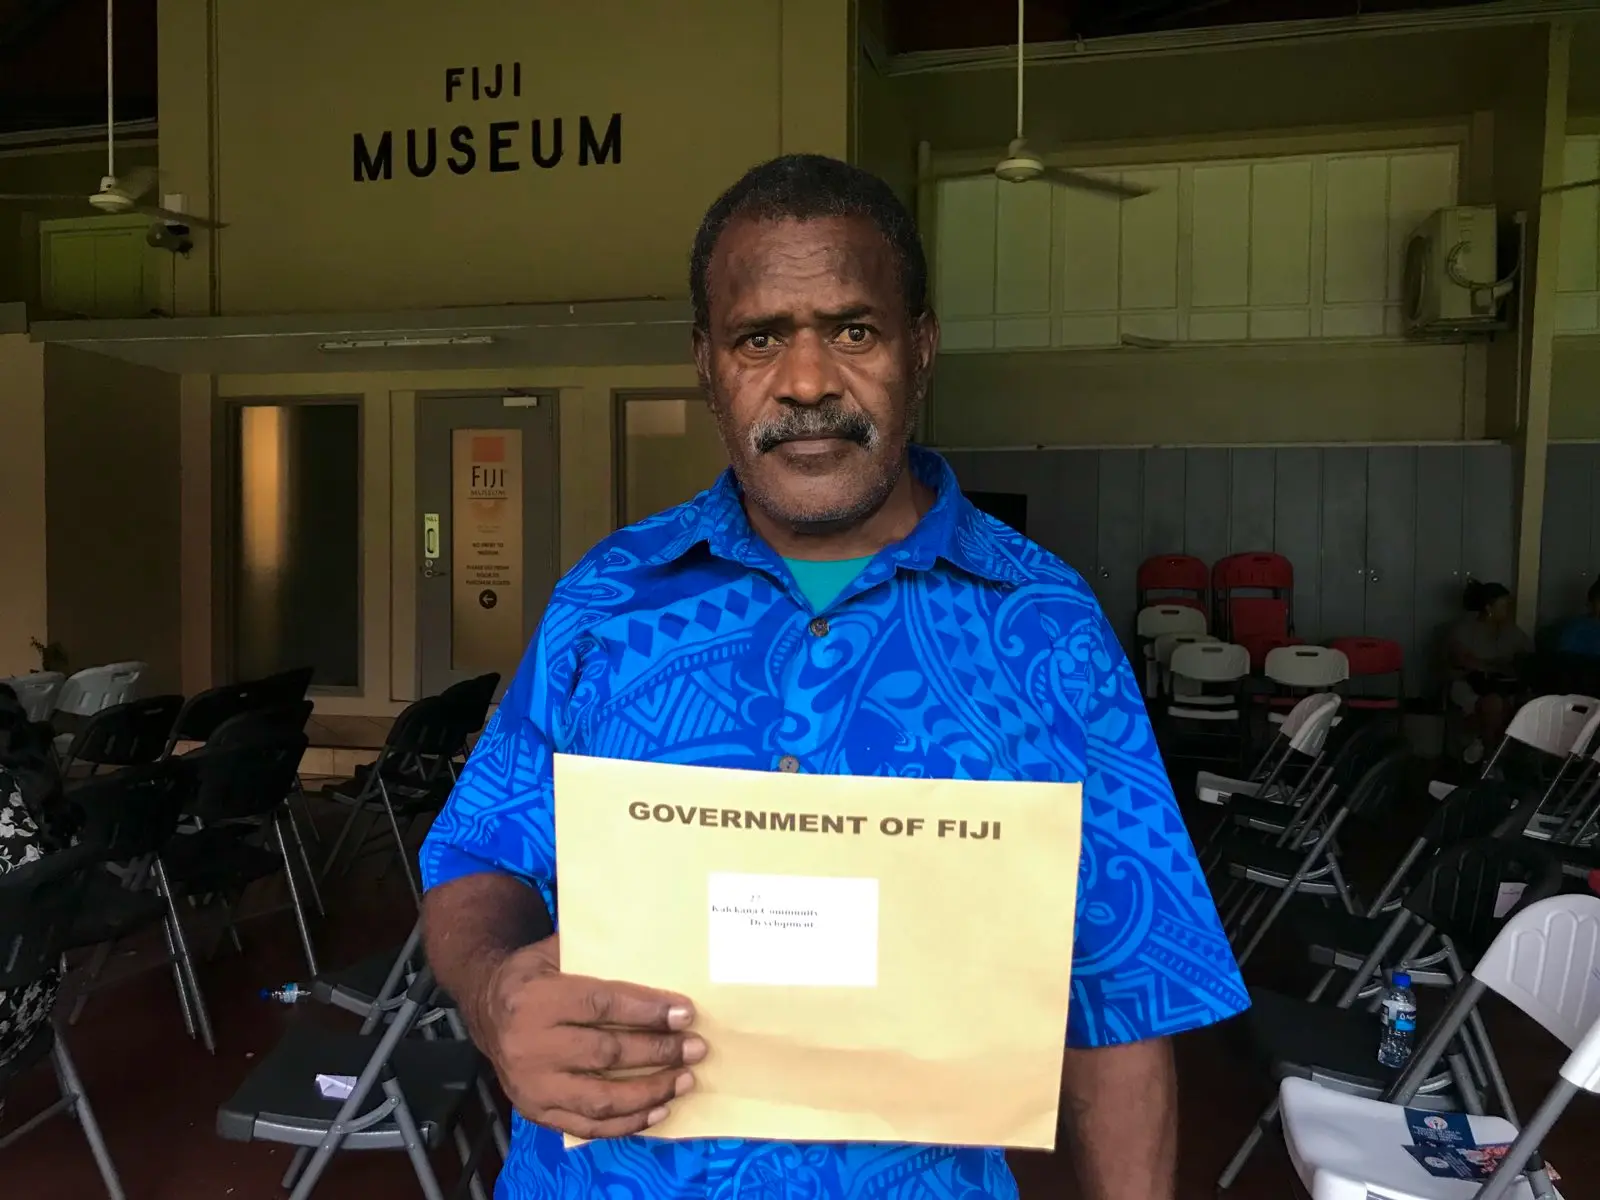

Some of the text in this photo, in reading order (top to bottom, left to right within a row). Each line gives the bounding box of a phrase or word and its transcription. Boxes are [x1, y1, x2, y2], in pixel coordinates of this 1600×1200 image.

[445, 62, 521, 103] FIJI
[353, 113, 622, 182] MUSEUM
[472, 465, 504, 488] FIJI
[628, 801, 1002, 840] GOVERNMENT OF FIJI
[750, 918, 814, 929] Development
[760, 906, 819, 917] Community
